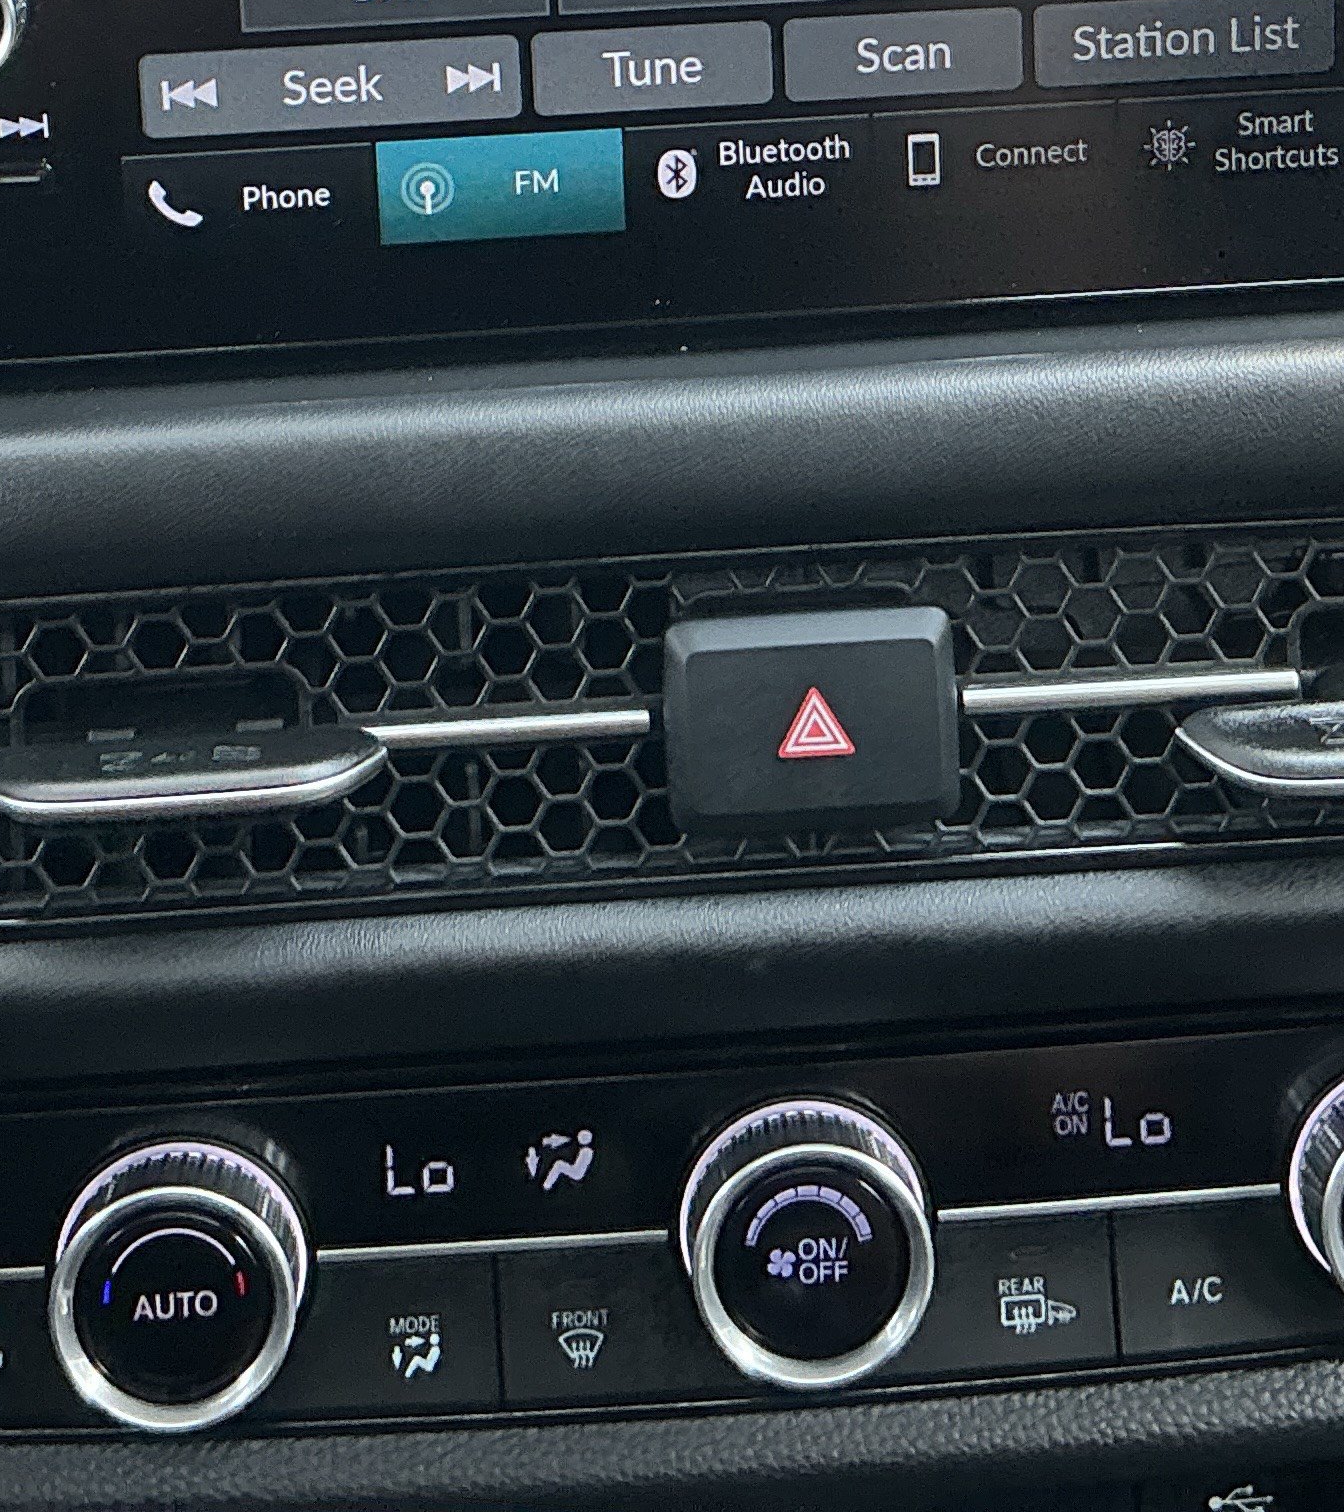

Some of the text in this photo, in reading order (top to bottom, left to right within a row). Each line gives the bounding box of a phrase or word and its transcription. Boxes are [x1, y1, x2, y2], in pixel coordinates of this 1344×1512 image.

[1073, 15, 1300, 61] Station List
[602, 51, 703, 88] Tune
[857, 38, 952, 74] Scan
[283, 65, 383, 106] Seek
[1238, 109, 1314, 136] Smart
[719, 134, 850, 166] Bluetooth
[976, 139, 1088, 167] Connect
[1215, 144, 1339, 172] Shortcuts
[515, 168, 559, 195] FM
[745, 171, 826, 199] Audio
[243, 184, 331, 211] Phone
[1052, 1091, 1089, 1113] A/C
[1055, 1114, 1088, 1135] ON
[799, 1261, 849, 1285] OFF
[998, 1276, 1046, 1296] REAR
[1170, 1275, 1222, 1307] A/C
[133, 1290, 218, 1321] AUTO
[551, 1309, 607, 1329] FRONT
[389, 1314, 440, 1336] MODE
